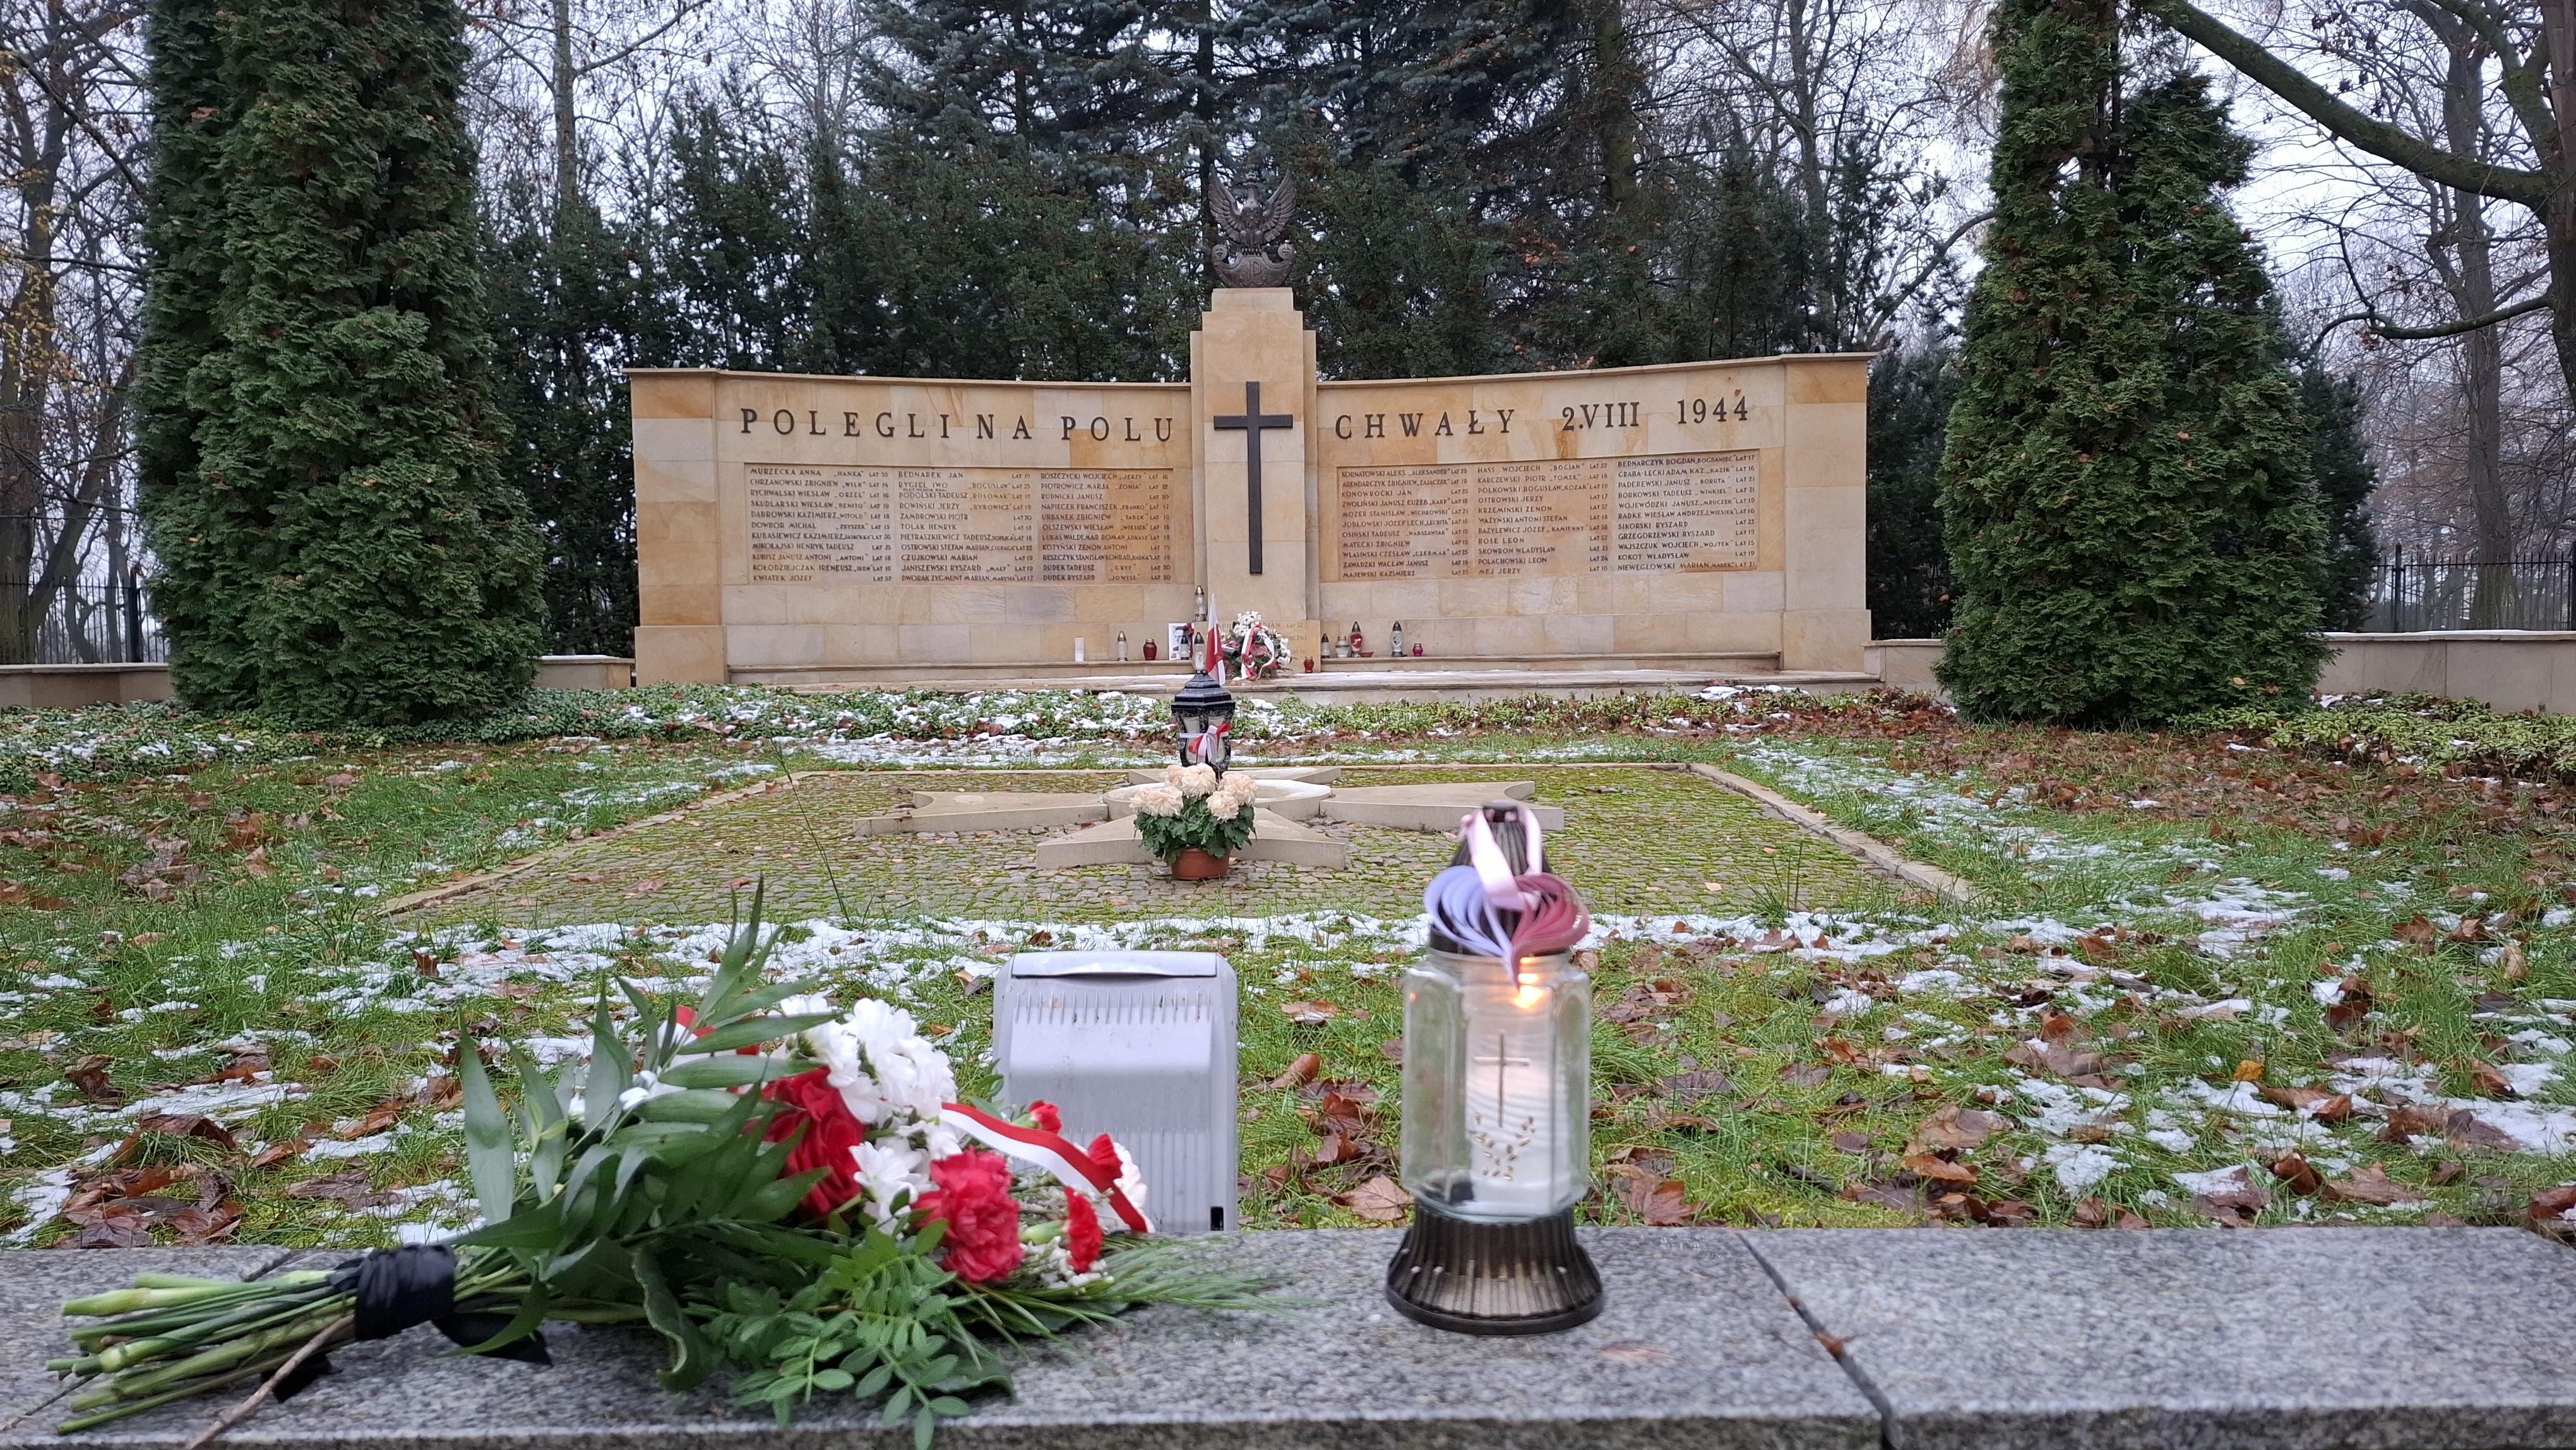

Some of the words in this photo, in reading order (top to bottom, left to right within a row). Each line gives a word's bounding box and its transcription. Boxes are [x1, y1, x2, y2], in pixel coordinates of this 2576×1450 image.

[740, 407, 950, 438] POLEGLI
[976, 414, 1032, 440] NA
[1060, 416, 1173, 441] POLU
[1335, 409, 1515, 439] CHWAŁY
[1561, 401, 1640, 431] 2.VIII
[1677, 395, 1749, 424] 1944
[1618, 459, 1664, 467] BEDNARCZYK
[1618, 542, 1658, 550] WAJSZCZUK
